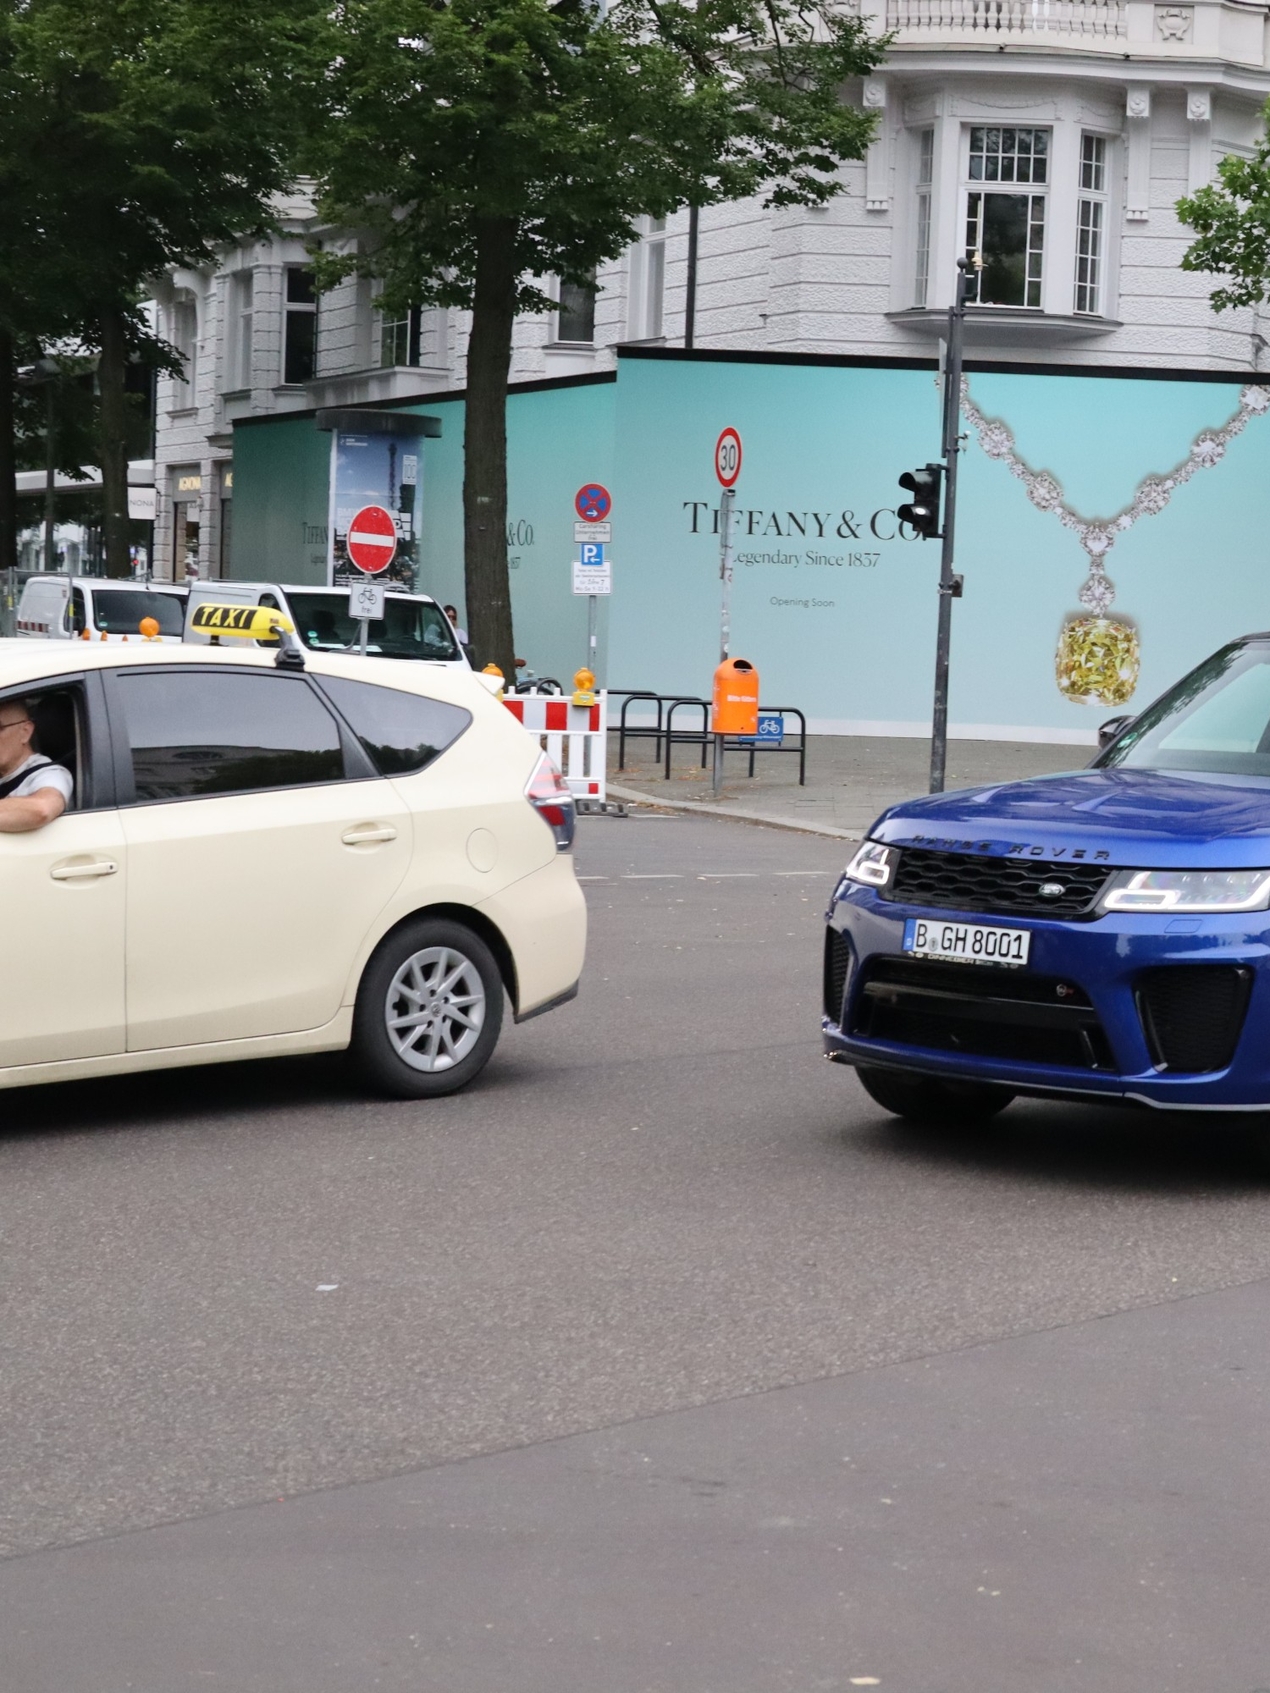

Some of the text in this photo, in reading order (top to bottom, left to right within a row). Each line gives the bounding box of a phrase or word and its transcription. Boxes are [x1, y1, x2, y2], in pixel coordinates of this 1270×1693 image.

[720, 444, 736, 471] 30
[683, 502, 832, 538] TIFFANY
[836, 509, 864, 539] &
[583, 544, 598, 563] P
[805, 550, 844, 567] Since
[848, 552, 881, 568] 1837
[361, 605, 373, 614] frei
[769, 596, 835, 608] Opening Soon
[200, 606, 249, 628] TAXI
[911, 835, 1111, 860] RANGE ROVER
[916, 923, 1023, 960] B GH 8001
